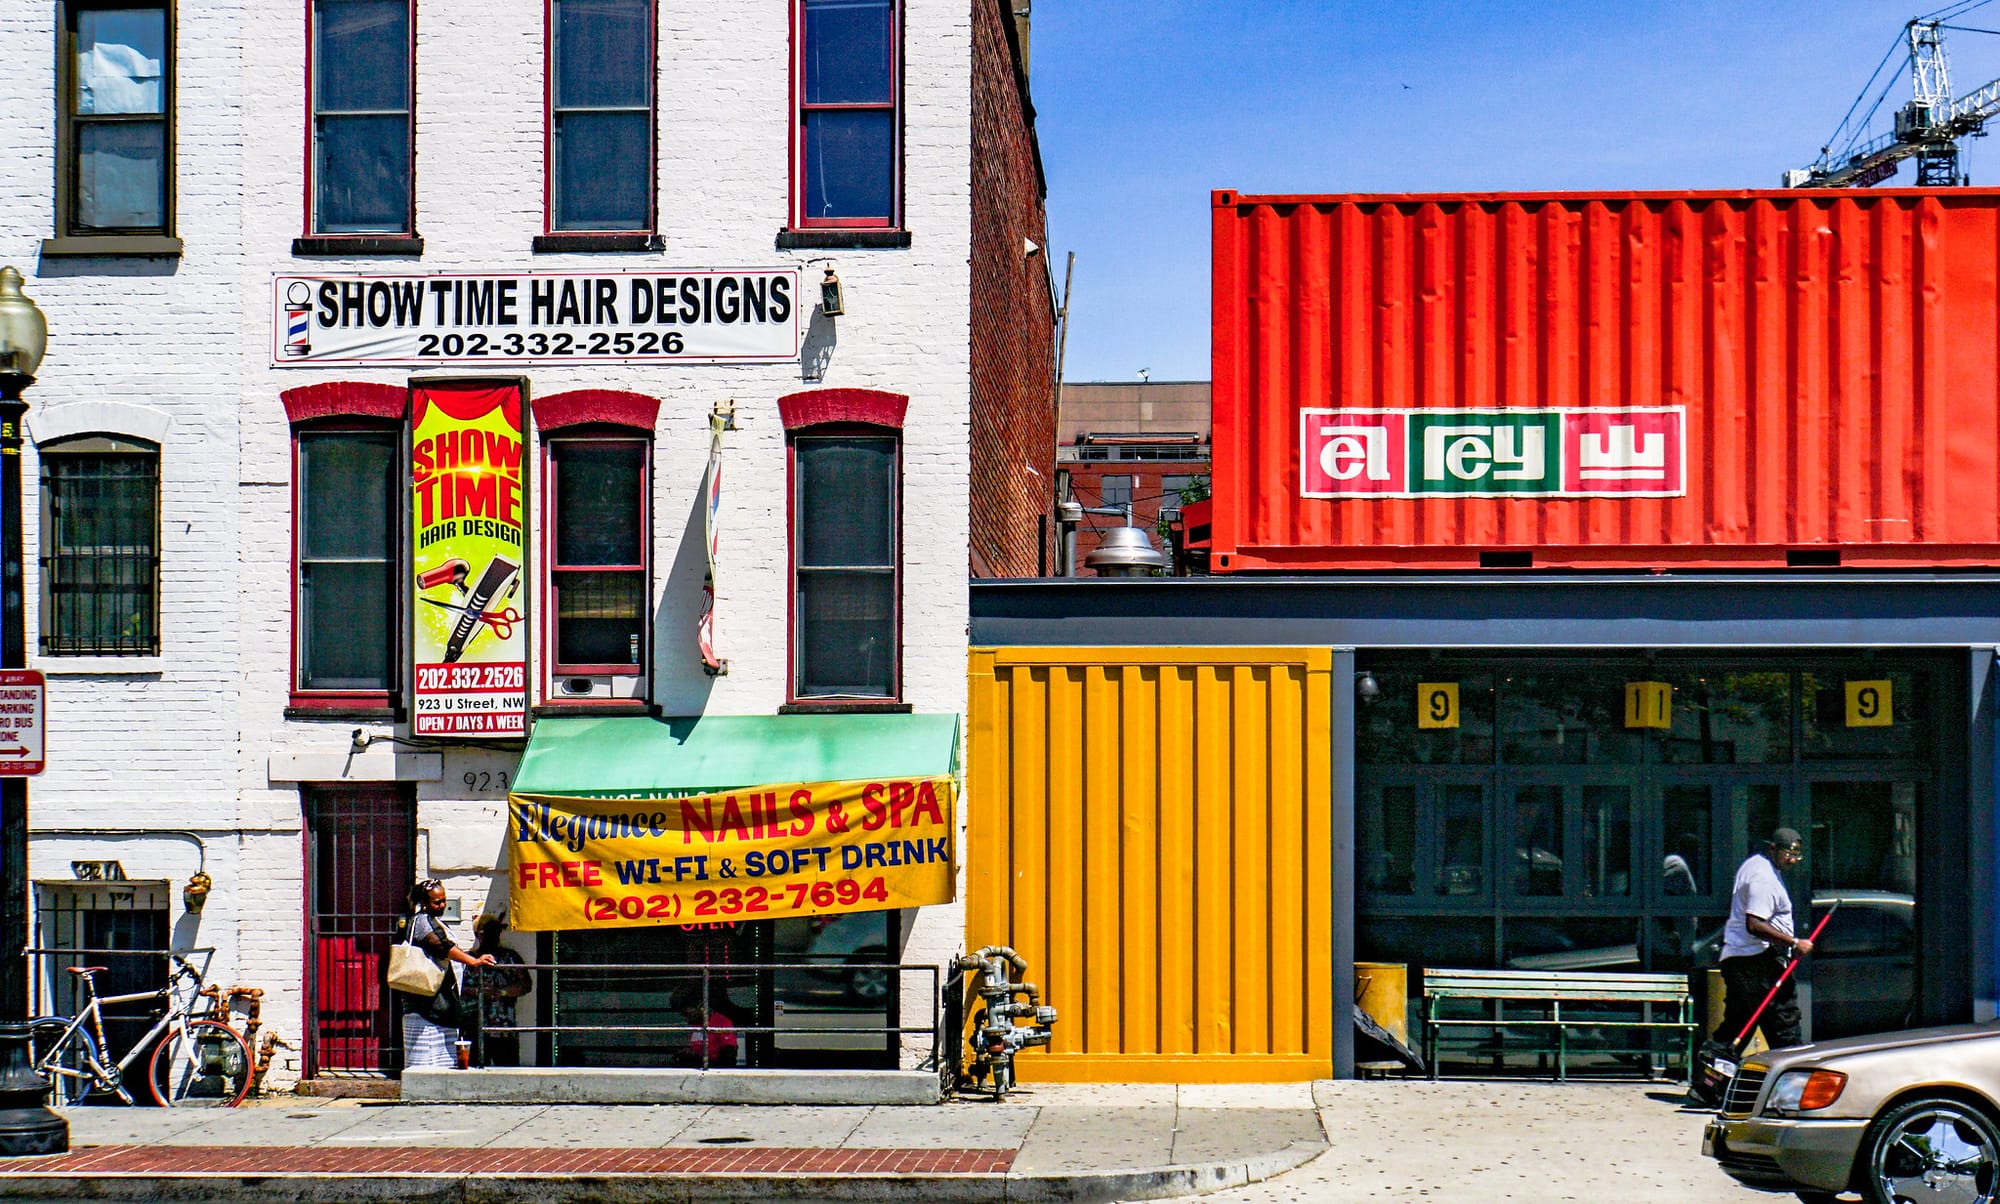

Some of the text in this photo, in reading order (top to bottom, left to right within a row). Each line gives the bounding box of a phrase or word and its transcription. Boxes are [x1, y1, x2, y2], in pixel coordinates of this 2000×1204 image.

[530, 278, 619, 325] HAIR
[630, 275, 791, 325] DESIGNS
[418, 332, 684, 356] 202-332-2526
[413, 428, 523, 482] SHOW
[1320, 426, 1545, 480] el rey
[415, 472, 521, 530] TIME
[420, 519, 521, 549] HAIR DESIGN
[418, 666, 524, 690] 202.332.2526
[0, 689, 37, 700] TANDING
[418, 697, 524, 710] 923 U Street, NW
[1430, 690, 1450, 721] 9
[1858, 687, 1879, 719] 9
[0, 731, 19, 742] ONE
[14, 717, 34, 728] BUS
[419, 715, 525, 731] OPEN 7 DAYS A WEEK
[516, 780, 945, 853] Elegance NAILS & SPA
[519, 837, 949, 890] FREE WI-FI & SOFT DRINK
[583, 876, 889, 922] (202) 232-7694
